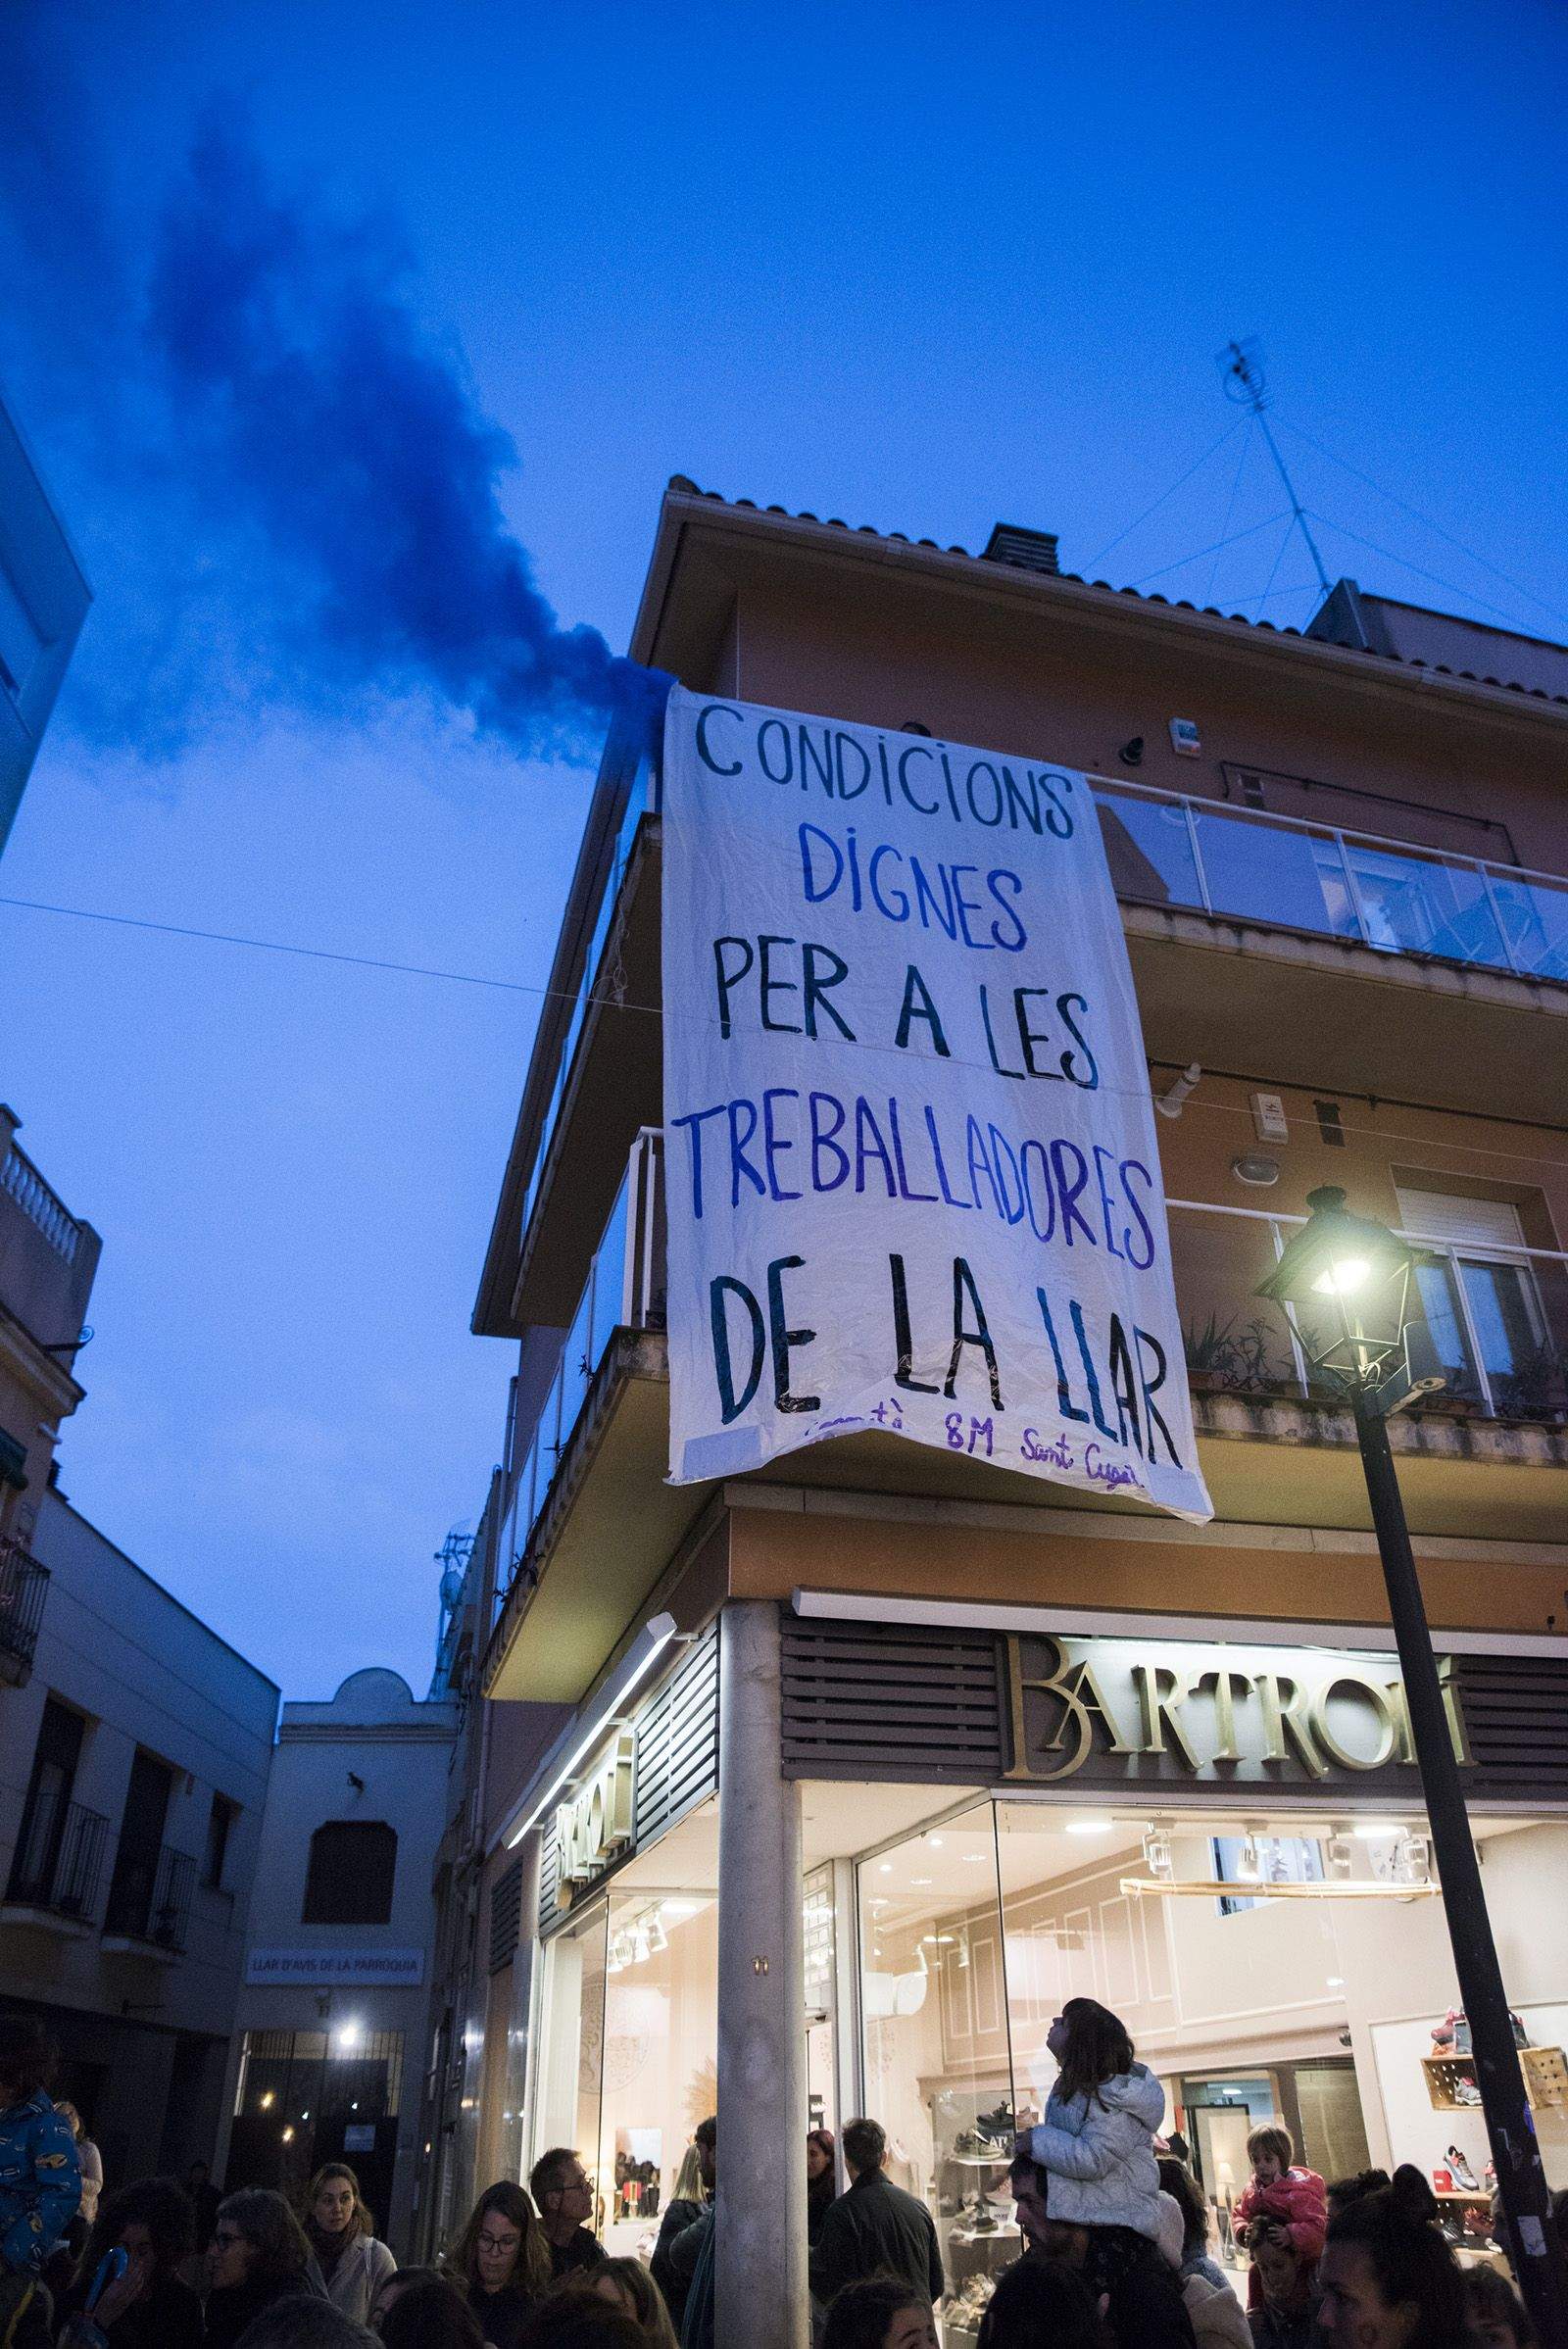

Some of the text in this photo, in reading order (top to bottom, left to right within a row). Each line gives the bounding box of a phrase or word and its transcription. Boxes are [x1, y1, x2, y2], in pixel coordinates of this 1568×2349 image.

[713, 935, 1099, 1090] PER A LES
[671, 1089, 1155, 1270] TREBALLADORES
[710, 1253, 1184, 1470] DE LA LLAR
[945, 1411, 994, 1457] 8M
[252, 1957, 278, 1972] LLAR
[319, 1957, 334, 1972] DE
[336, 1957, 351, 1972] LA
